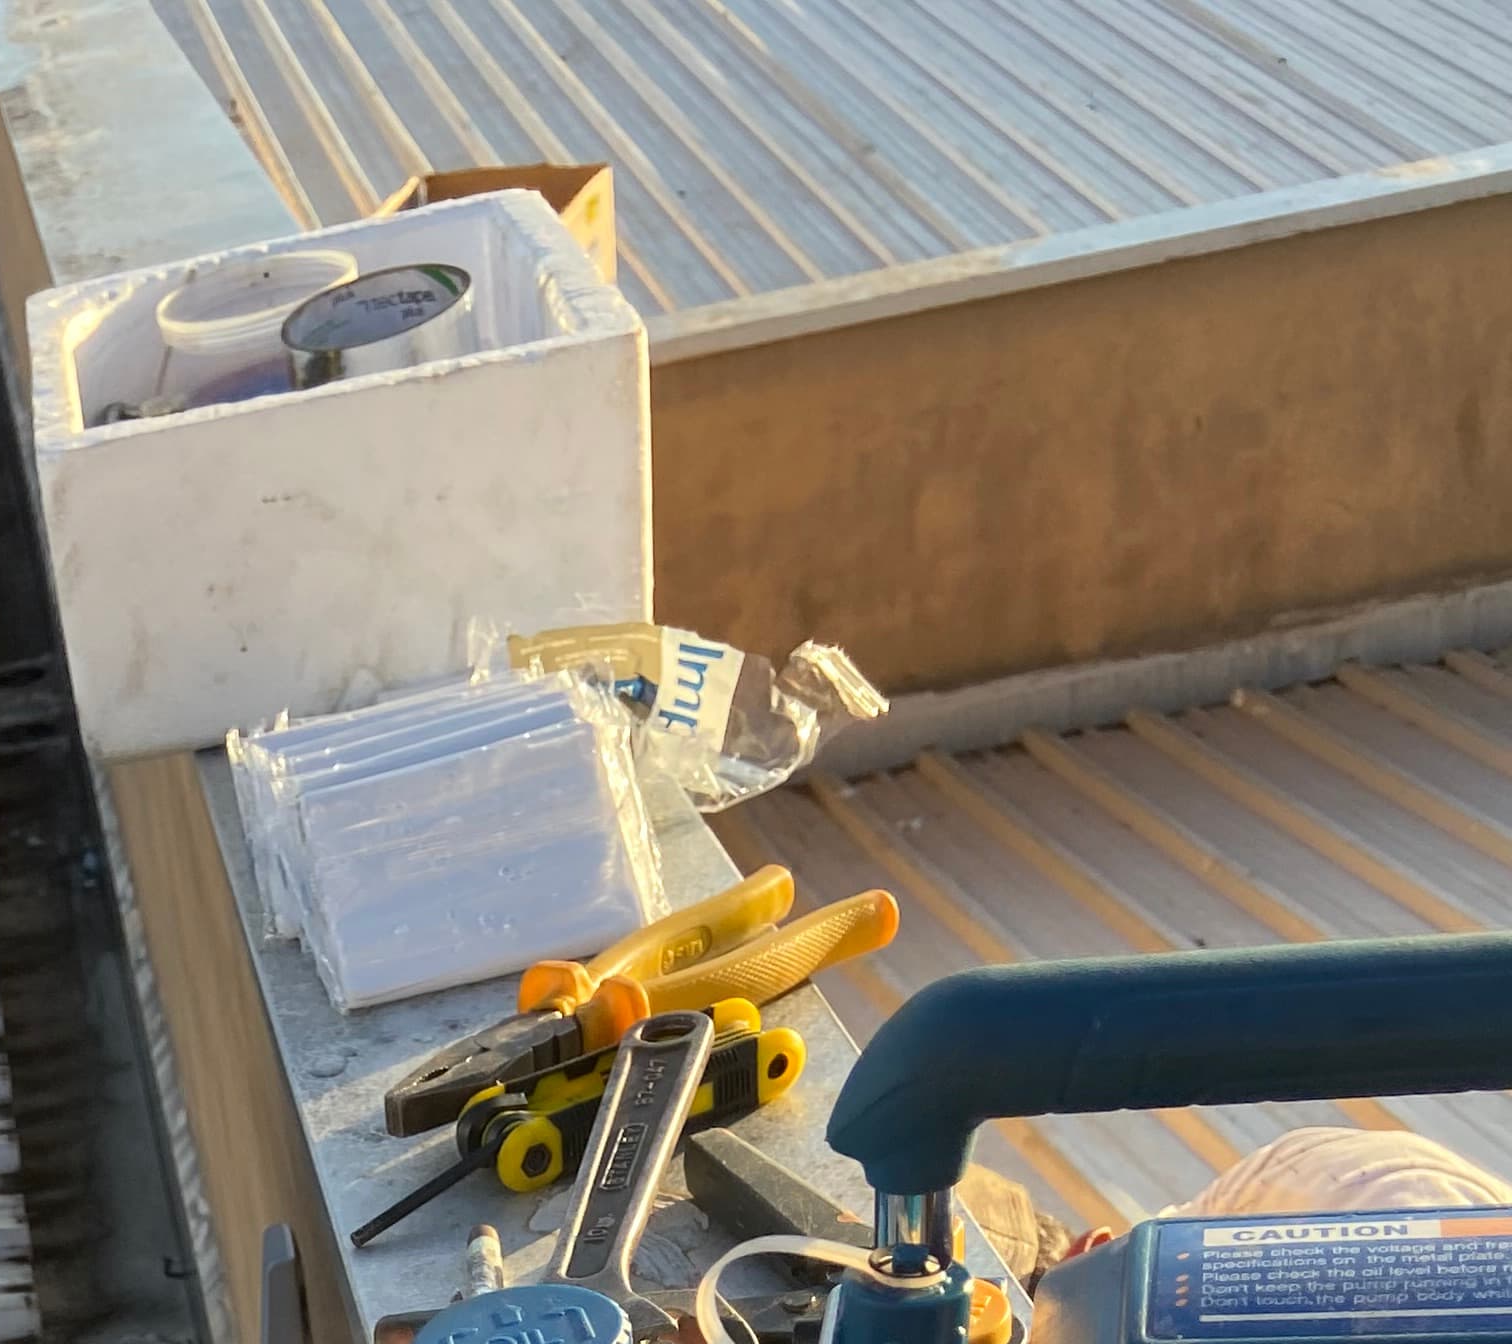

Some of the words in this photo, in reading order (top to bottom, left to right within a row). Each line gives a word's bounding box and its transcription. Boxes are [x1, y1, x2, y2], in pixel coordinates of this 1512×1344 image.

[1232, 1225, 1409, 1241] CAUTION
[1203, 1249, 1264, 1259] Please
[1270, 1247, 1325, 1257] check
[1332, 1246, 1361, 1255] the
[1367, 1243, 1436, 1255] voltage
[1442, 1241, 1478, 1251] and
[1201, 1257, 1328, 1271] specifications
[1332, 1257, 1356, 1265] on
[1367, 1254, 1396, 1264] the
[1401, 1252, 1453, 1263] metal
[1202, 1271, 1262, 1282] Please
[1267, 1270, 1321, 1280] check
[1327, 1268, 1356, 1278] the
[1361, 1267, 1383, 1277] oil
[1389, 1265, 1431, 1277] level
[1437, 1264, 1497, 1275] before
[1201, 1284, 1249, 1295] Don't
[1255, 1282, 1302, 1294] keep
[1308, 1281, 1337, 1293] the
[1343, 1279, 1397, 1292] pump
[1315, 1294, 1346, 1305] the
[1353, 1292, 1409, 1305] pump
